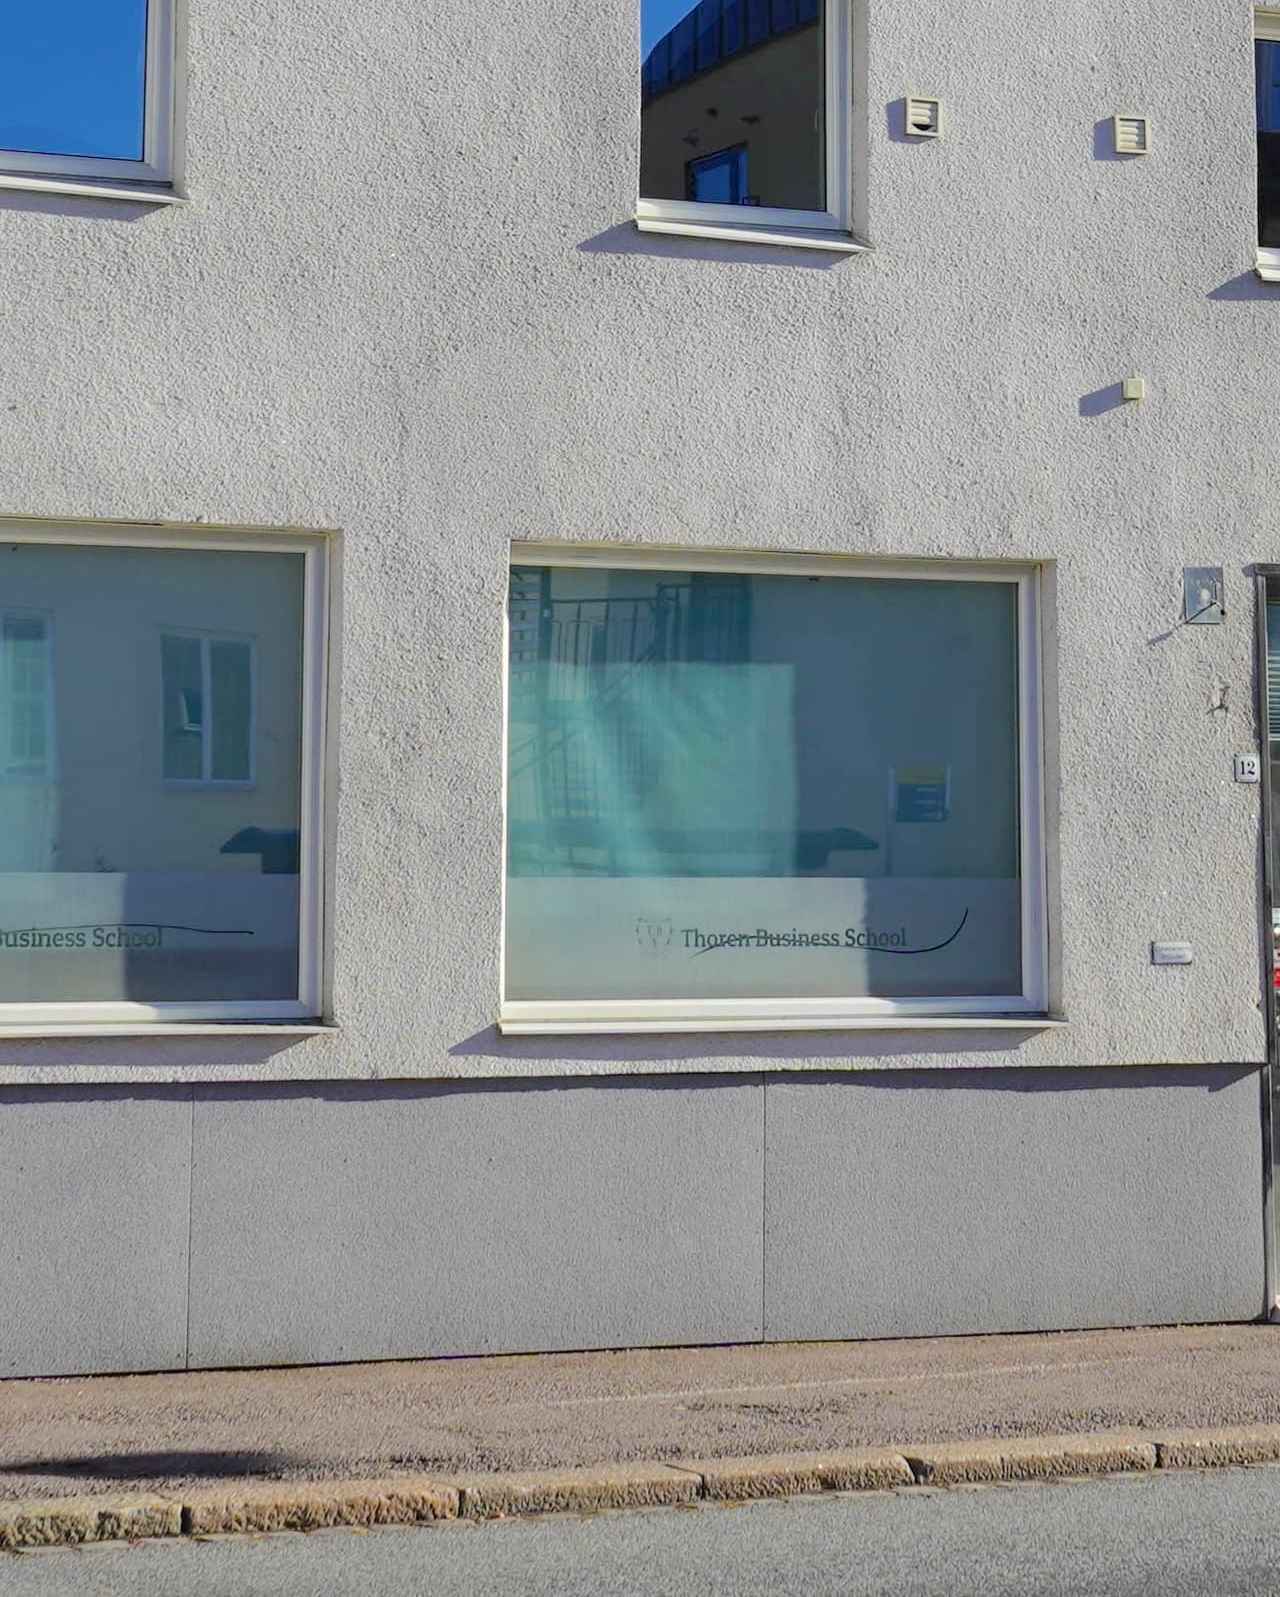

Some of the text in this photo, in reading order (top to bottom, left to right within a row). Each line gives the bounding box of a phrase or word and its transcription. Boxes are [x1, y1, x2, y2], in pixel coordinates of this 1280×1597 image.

[1240, 760, 1256, 776] 12
[0, 927, 162, 948] usiness School
[681, 928, 907, 948] Thoren Business School
